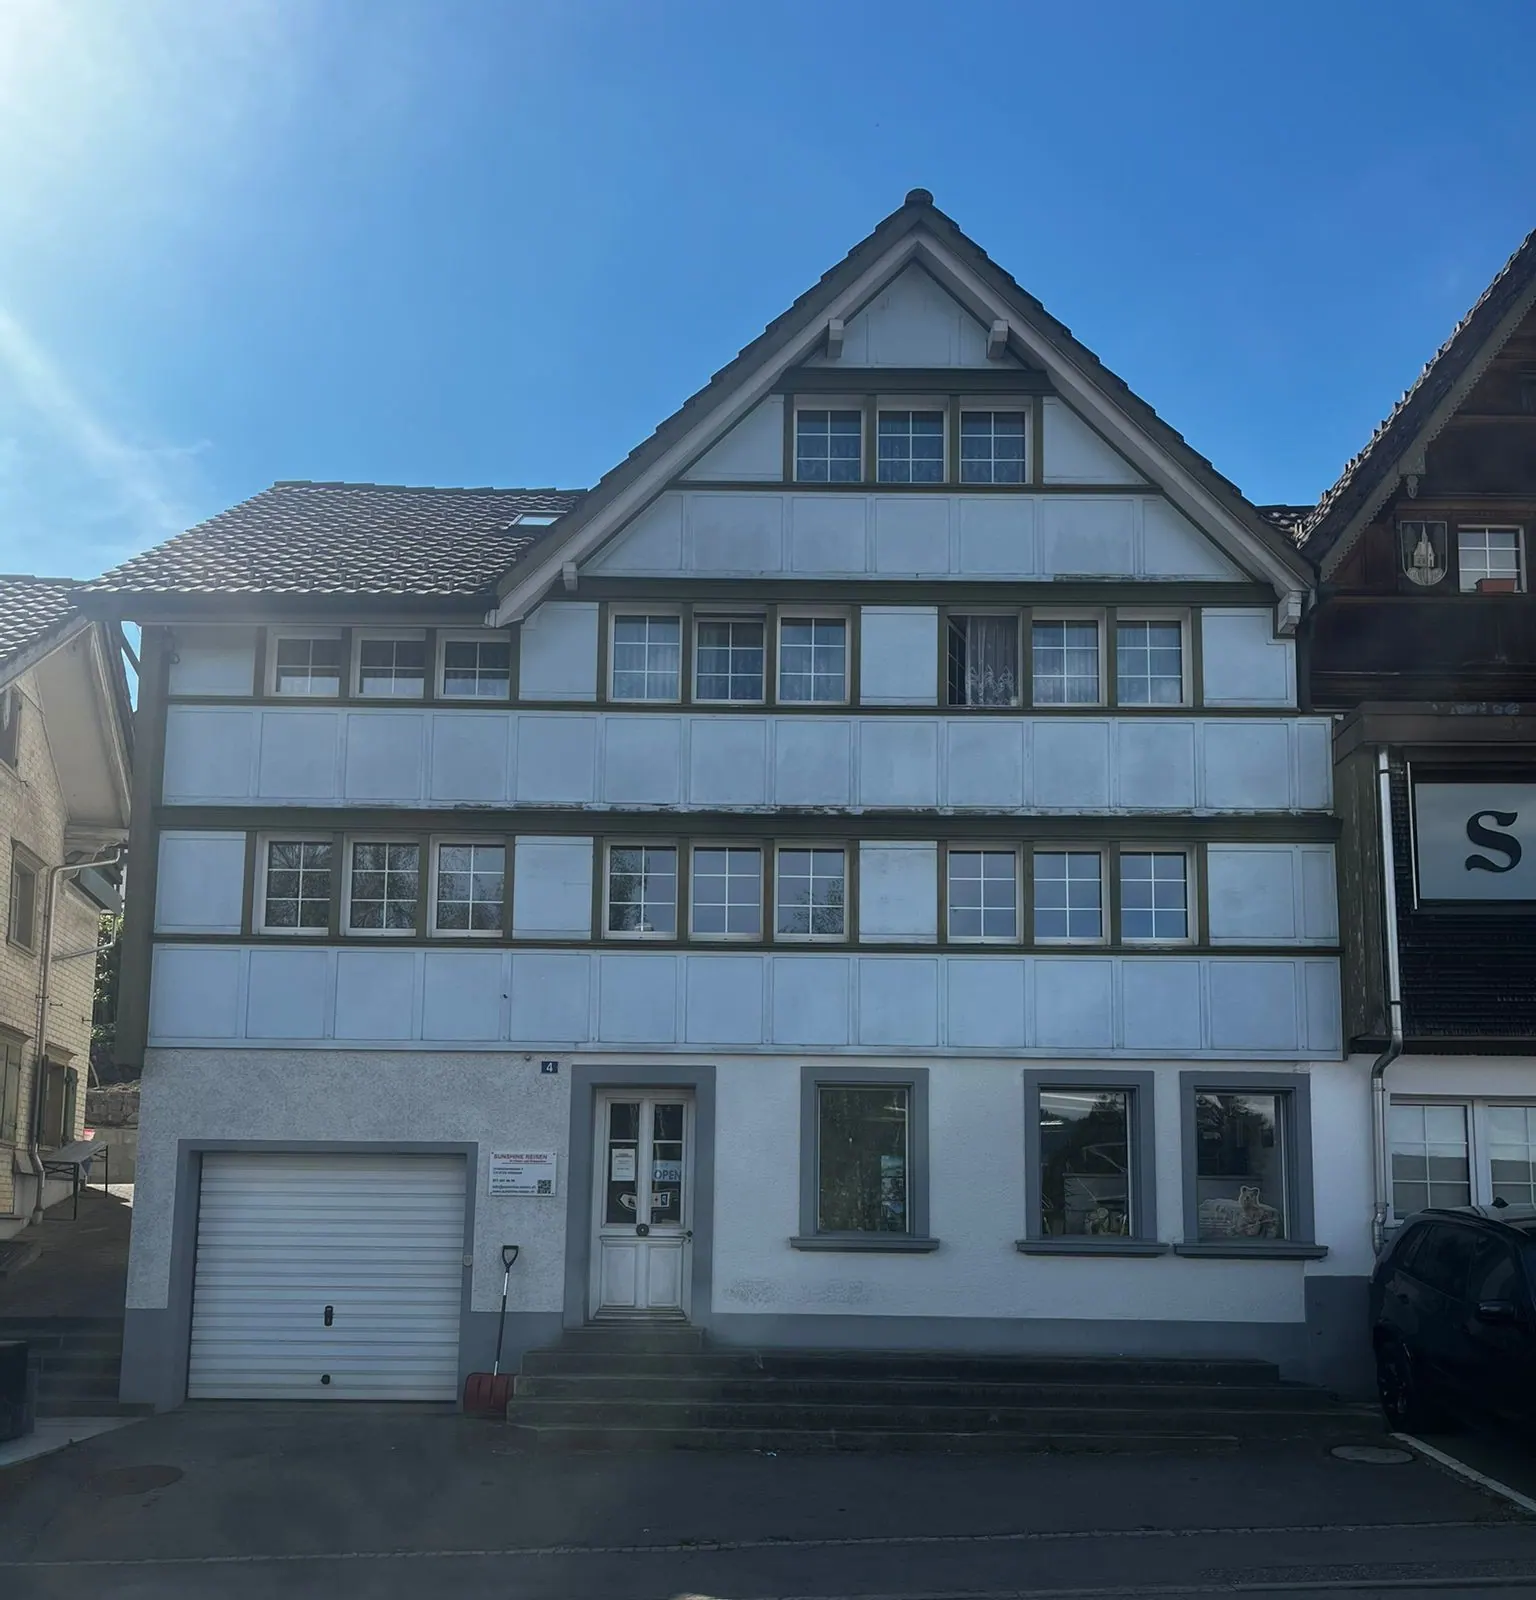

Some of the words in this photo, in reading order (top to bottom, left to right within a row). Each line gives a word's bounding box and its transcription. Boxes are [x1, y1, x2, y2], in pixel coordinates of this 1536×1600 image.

[1465, 810, 1522, 873] S
[546, 1062, 553, 1073] 4
[654, 1169, 682, 1180] OPEN
